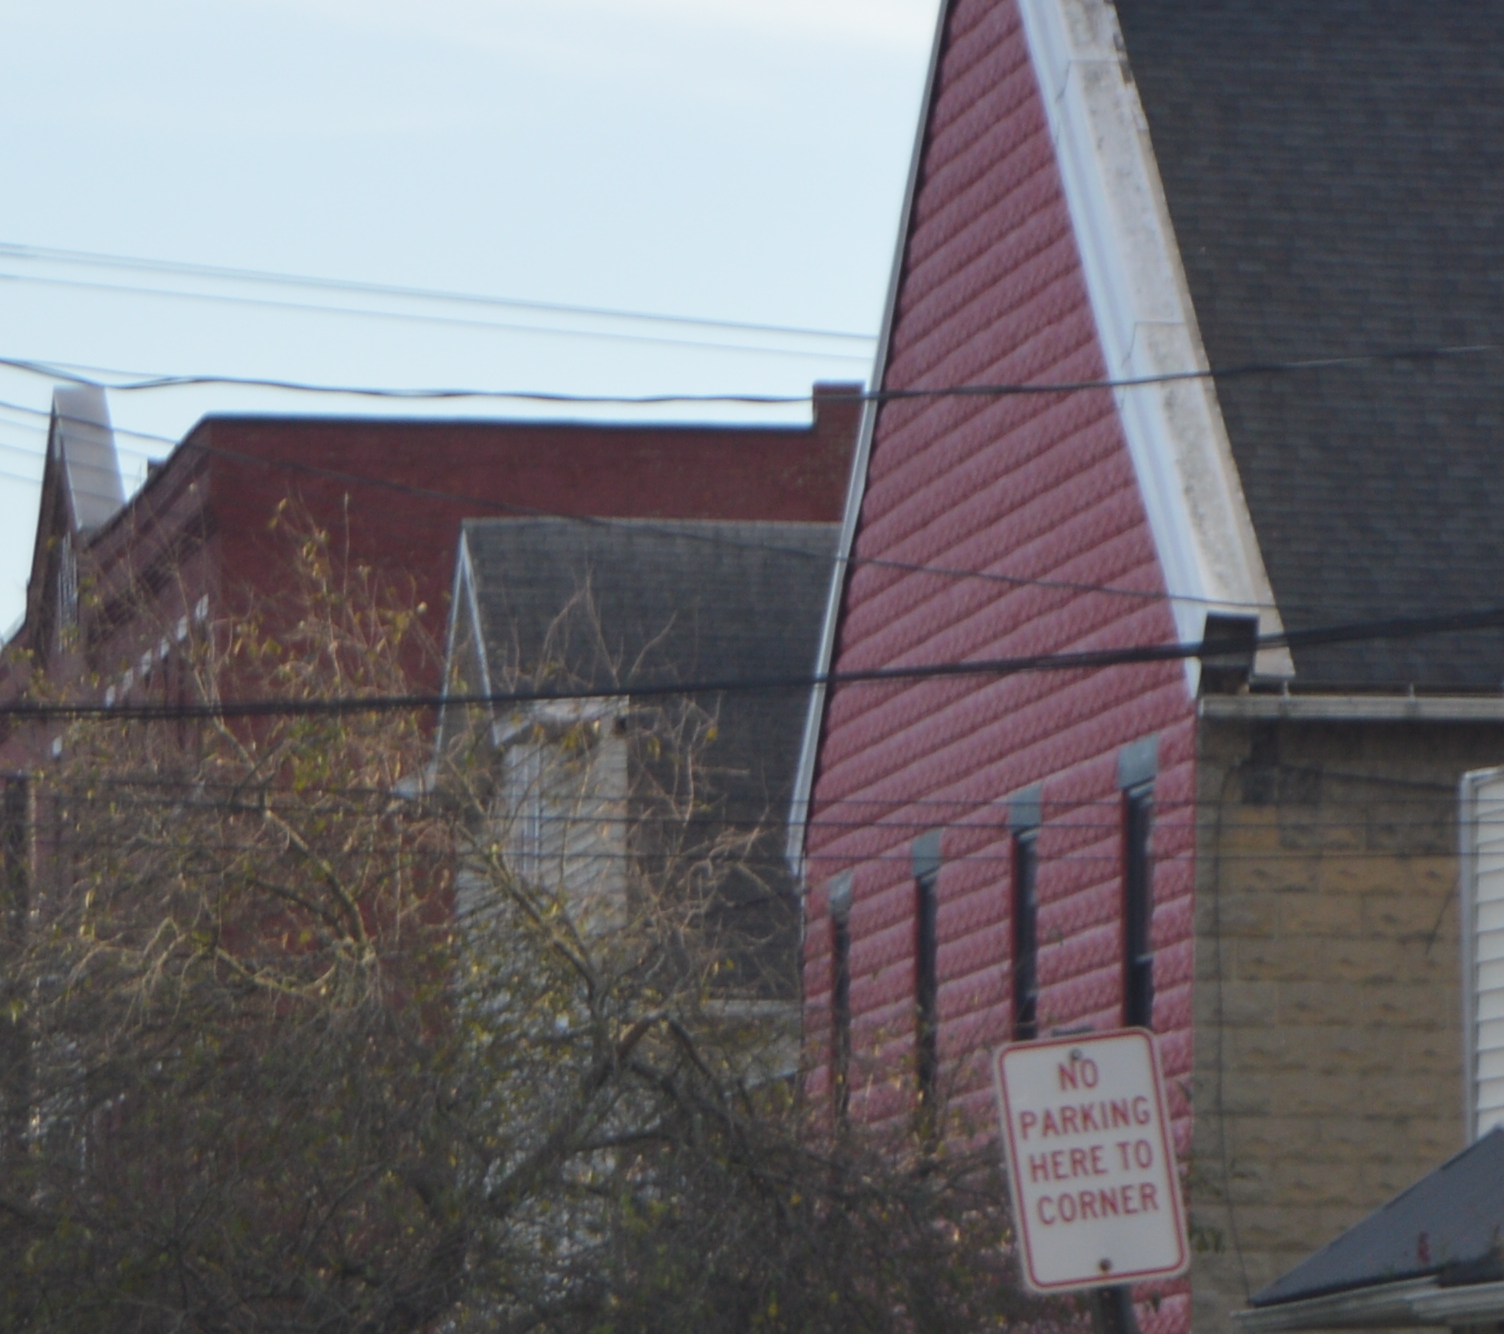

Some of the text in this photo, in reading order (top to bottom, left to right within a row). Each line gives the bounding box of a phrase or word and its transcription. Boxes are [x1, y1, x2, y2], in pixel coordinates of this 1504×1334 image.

[1057, 1058, 1099, 1092] NO
[1018, 1095, 1151, 1141] PARKING
[1028, 1139, 1153, 1183] HERE TO
[1037, 1182, 1159, 1226] CORNER
